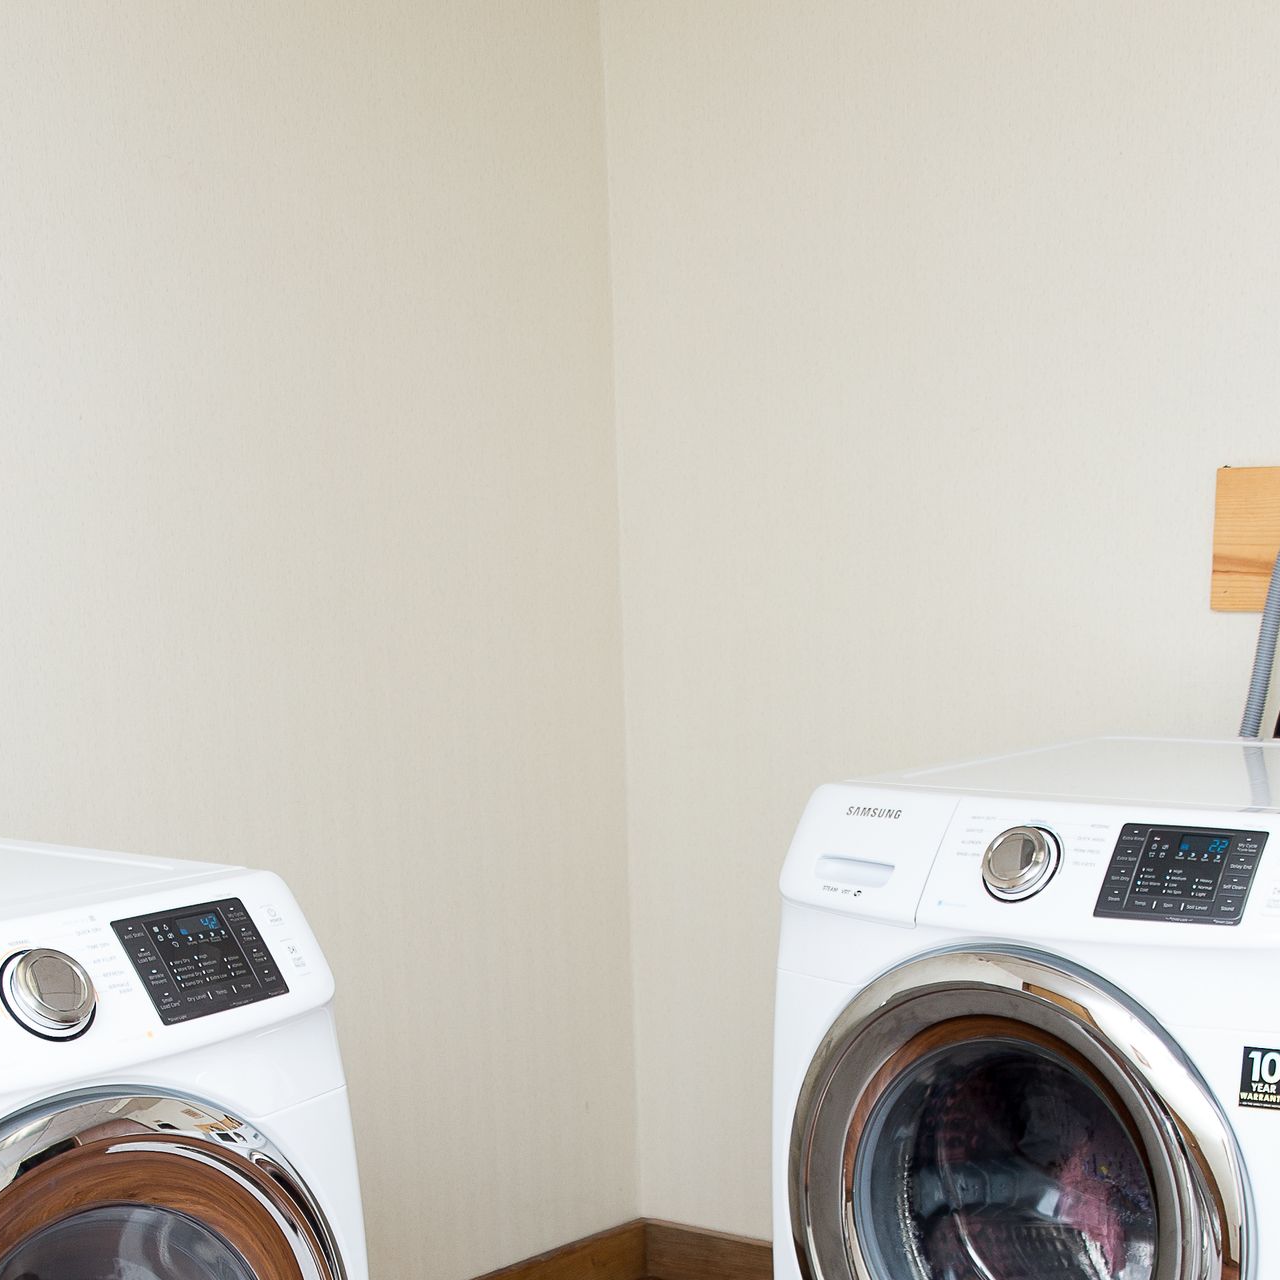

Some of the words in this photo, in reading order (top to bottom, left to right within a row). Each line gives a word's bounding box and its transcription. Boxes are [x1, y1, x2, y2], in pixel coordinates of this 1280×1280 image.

[846, 806, 902, 820] SAMSUNG
[1208, 839, 1230, 853] 22
[1251, 1083, 1277, 1093] YEAR
